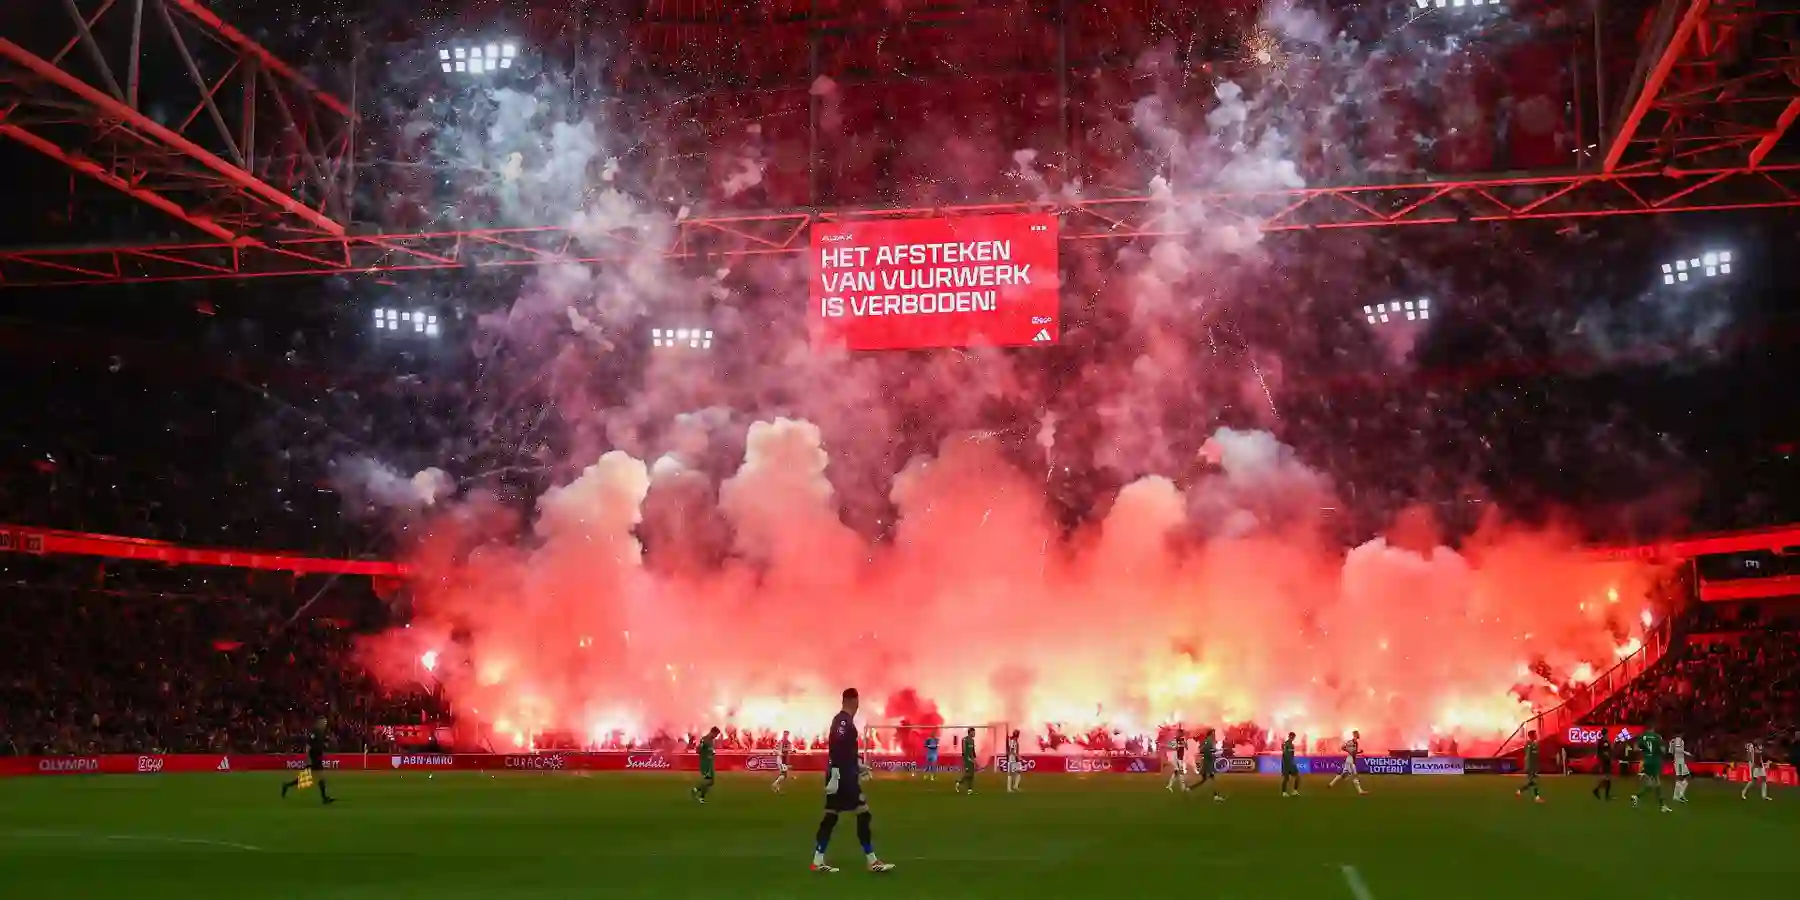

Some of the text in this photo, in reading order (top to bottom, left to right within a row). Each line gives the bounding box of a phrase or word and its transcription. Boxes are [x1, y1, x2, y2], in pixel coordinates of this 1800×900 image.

[821, 240, 1011, 269] HET AFSTEKEN
[821, 264, 1031, 293] VAN VUURWERK
[821, 291, 996, 317] IS VERBODEN!
[39, 758, 98, 771] OLYMPIA
[1364, 757, 1409, 766] VRIENDEN
[1412, 762, 1461, 770] OLYMPIA
[1369, 765, 1403, 774] LOTERIJ
